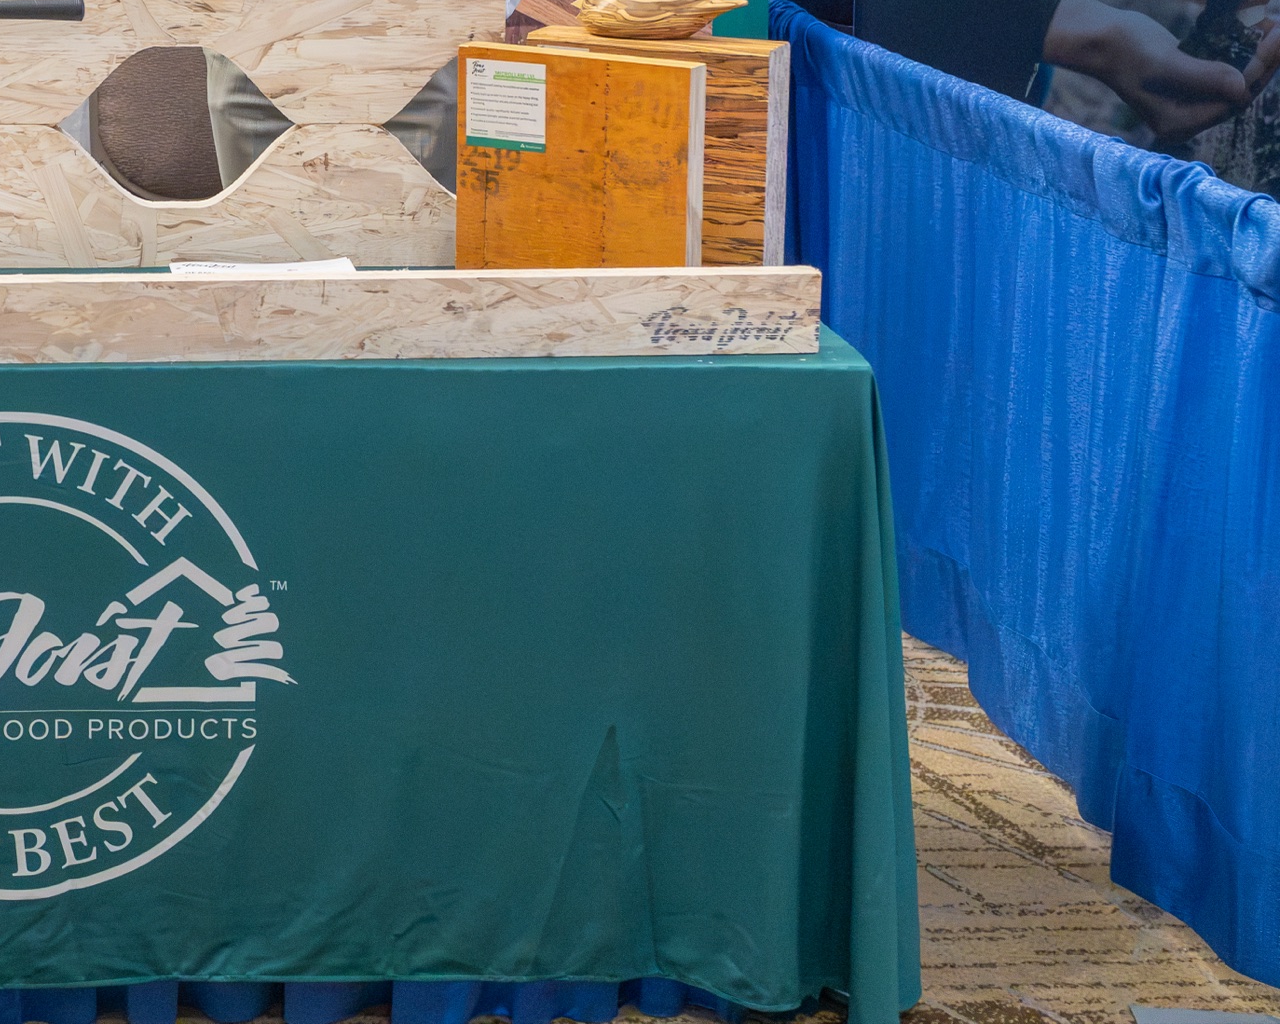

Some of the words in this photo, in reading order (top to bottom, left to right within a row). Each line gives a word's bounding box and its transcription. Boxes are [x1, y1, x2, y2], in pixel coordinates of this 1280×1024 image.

[24, 433, 193, 546] WITH
[88, 717, 258, 741] PRODUCTS
[7, 772, 173, 877] BEST
